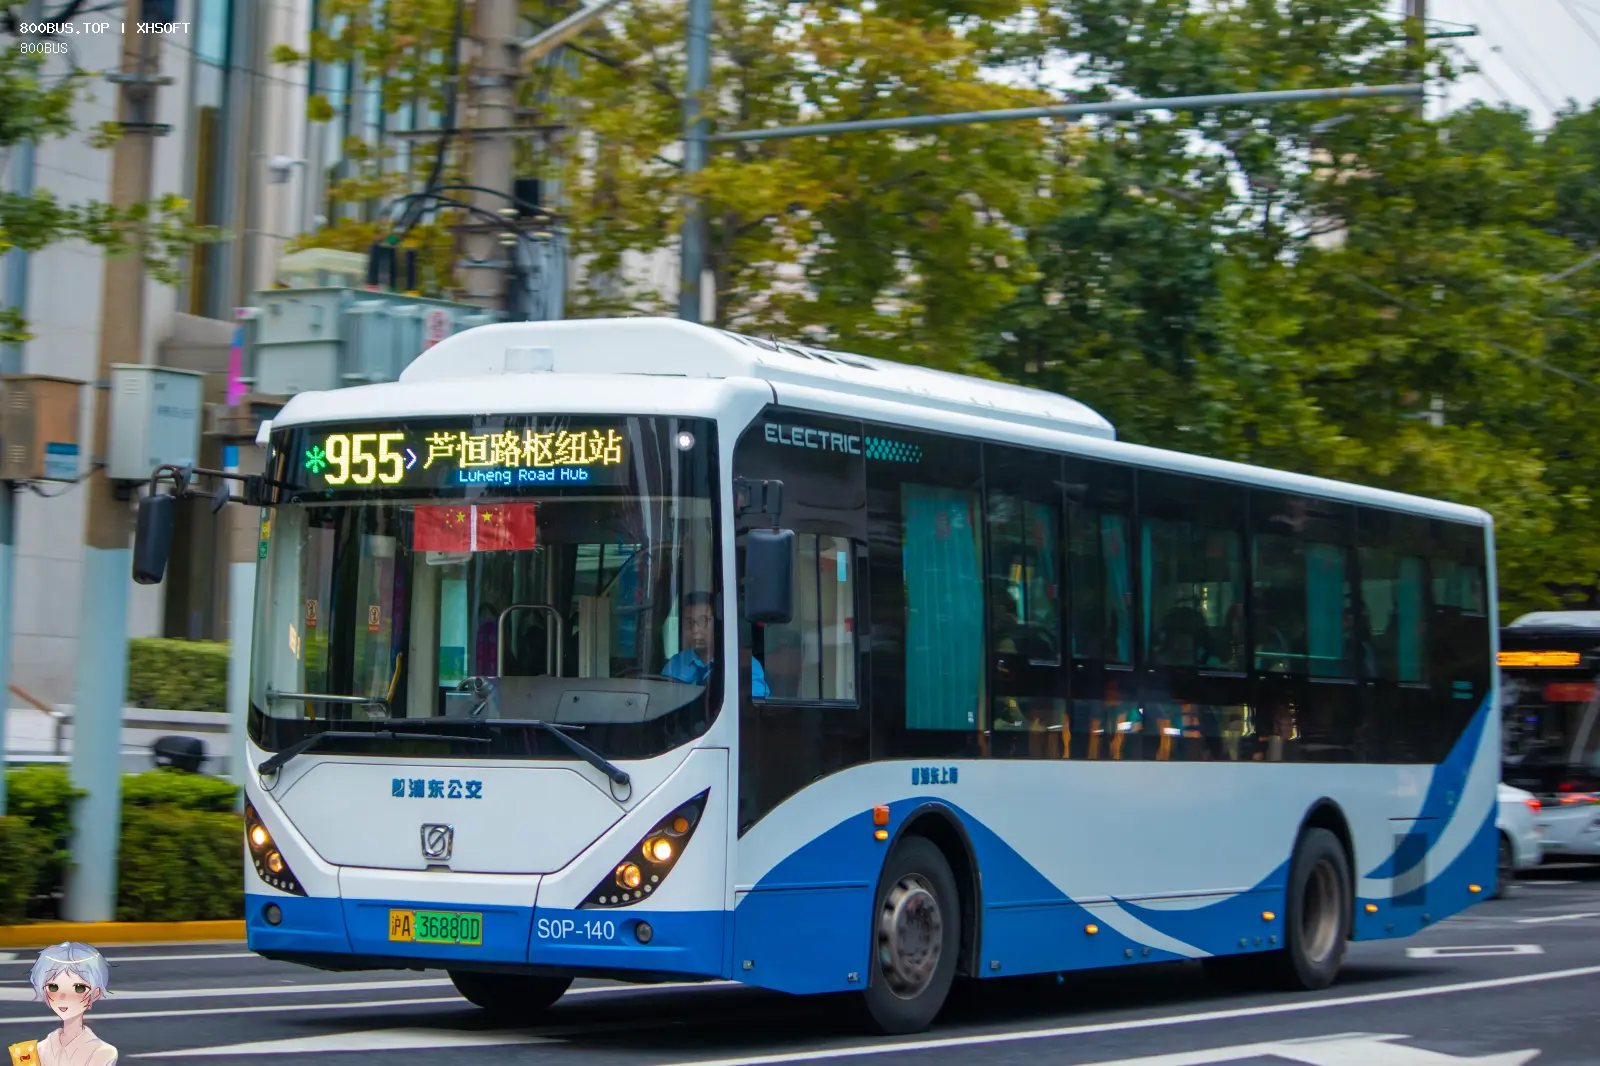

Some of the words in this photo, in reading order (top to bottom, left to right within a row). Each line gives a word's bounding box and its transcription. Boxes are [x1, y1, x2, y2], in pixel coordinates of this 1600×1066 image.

[423, 429, 622, 470] 芦恒路枢纽站
[764, 422, 861, 455] ELECTRIC
[324, 433, 405, 485] 955
[459, 469, 512, 485] Luheng
[518, 468, 555, 481] Road
[560, 468, 589, 480] Hub
[408, 778, 483, 799] 浦东公交
[419, 915, 480, 940] 36880D
